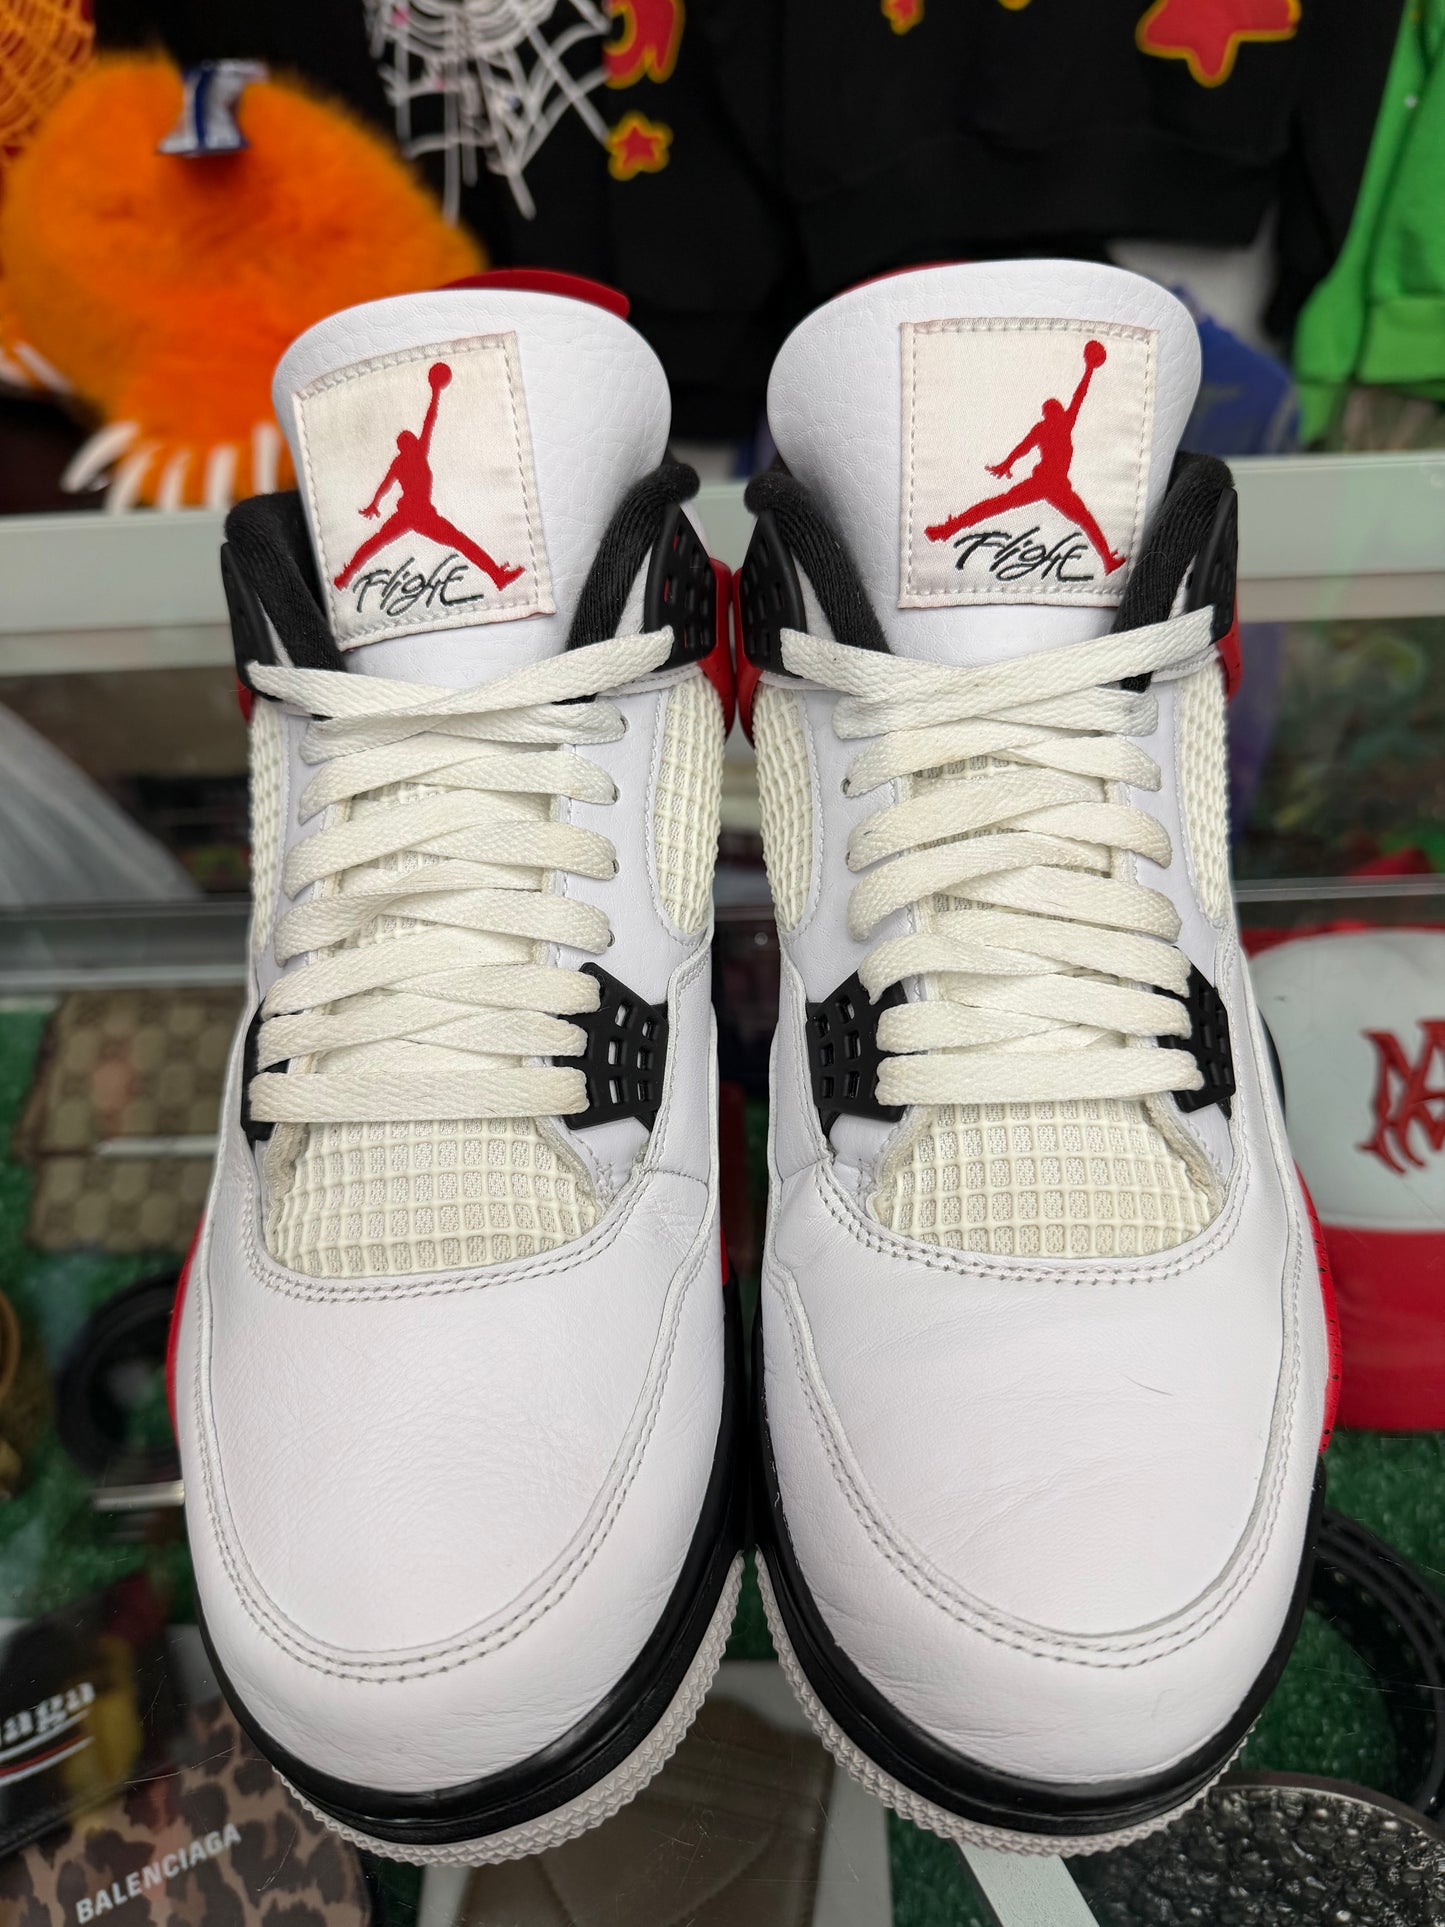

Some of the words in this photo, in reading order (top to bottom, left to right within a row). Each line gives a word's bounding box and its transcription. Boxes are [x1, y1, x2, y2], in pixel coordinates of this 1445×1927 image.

[353, 553, 484, 617] Flight
[953, 526, 1094, 582] Flight
[0, 1682, 96, 1746] aga
[75, 1822, 242, 1924] BALENCIAGA
